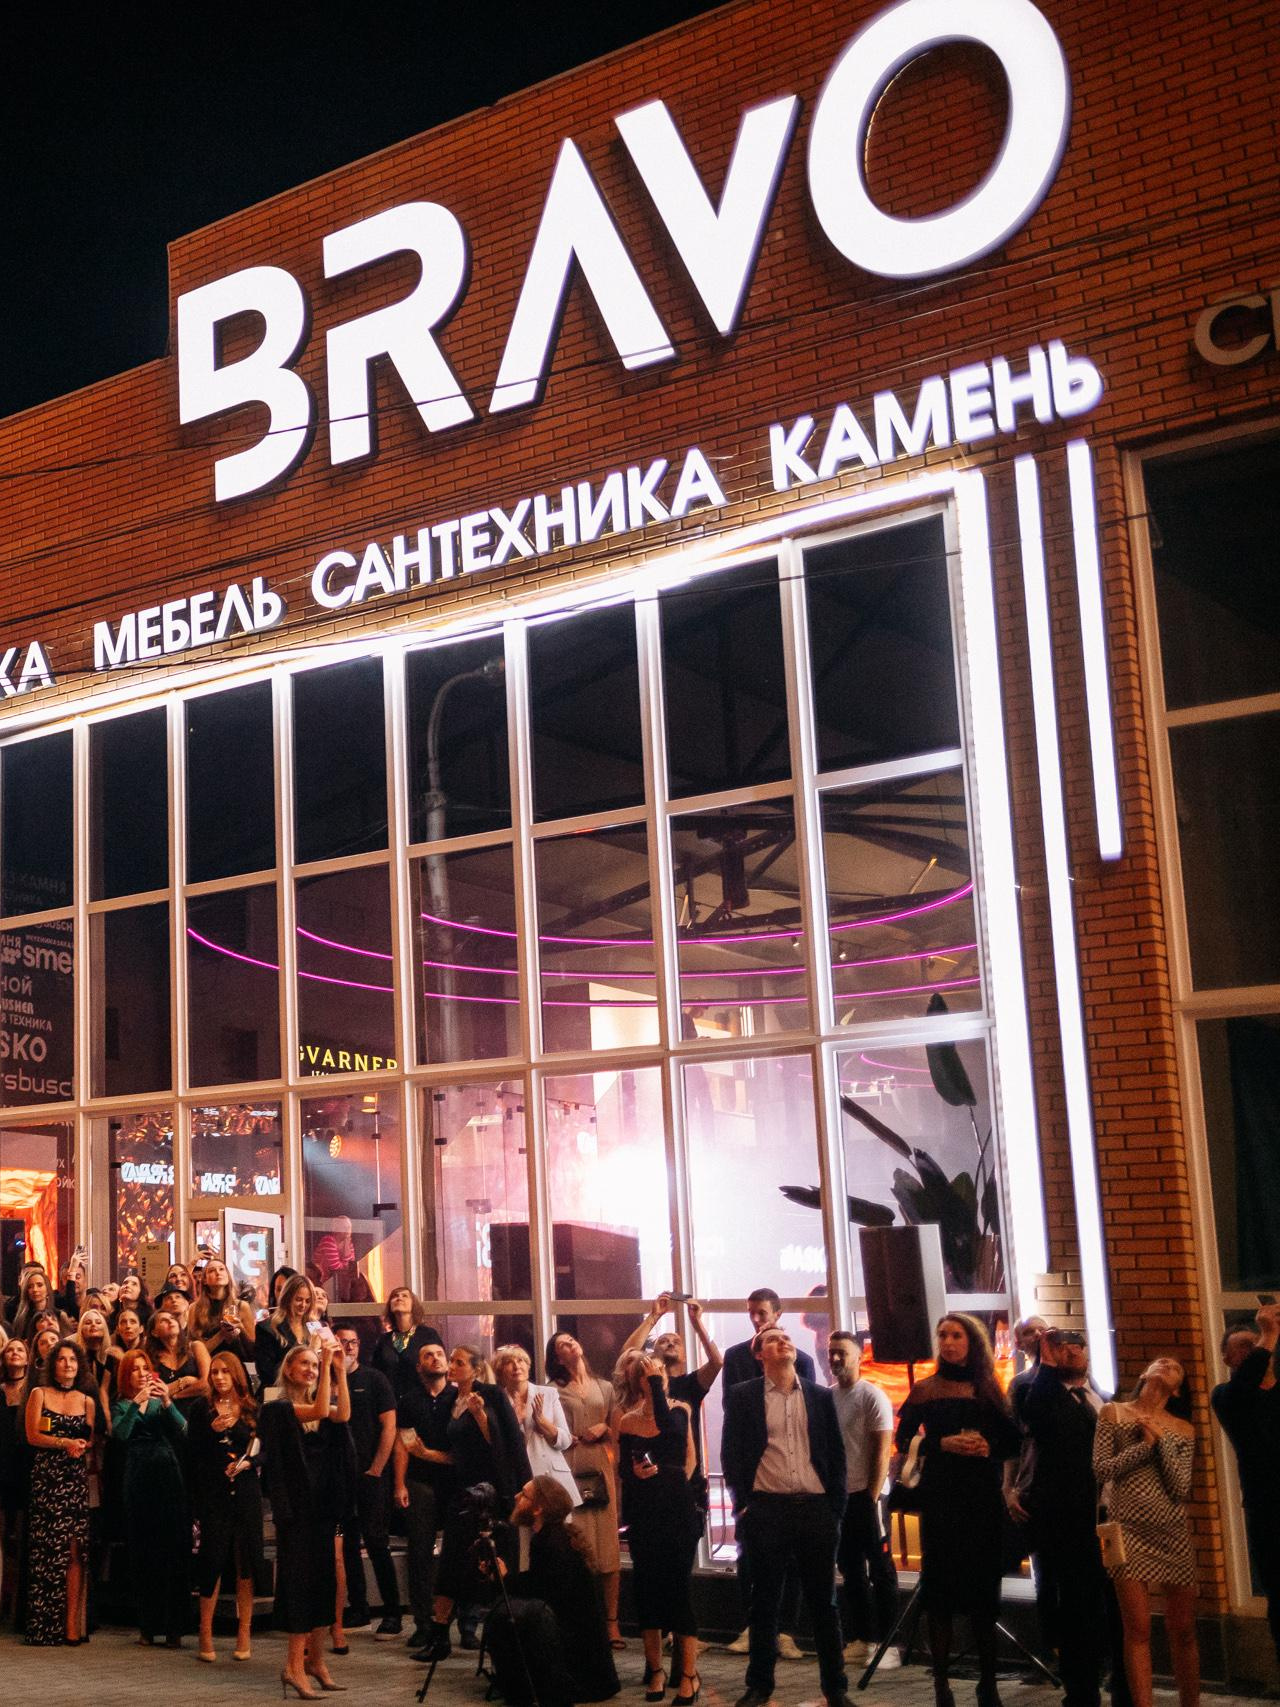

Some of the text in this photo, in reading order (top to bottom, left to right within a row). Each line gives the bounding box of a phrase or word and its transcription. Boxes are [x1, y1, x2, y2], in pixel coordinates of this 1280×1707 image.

[177, 0, 1070, 502] BRAVO
[768, 338, 1104, 492] КАМЕНЬ
[311, 447, 727, 609] САНТЕХНИКА
[93, 575, 286, 671] МЕБЕЛЬ
[22, 944, 74, 975] sme
